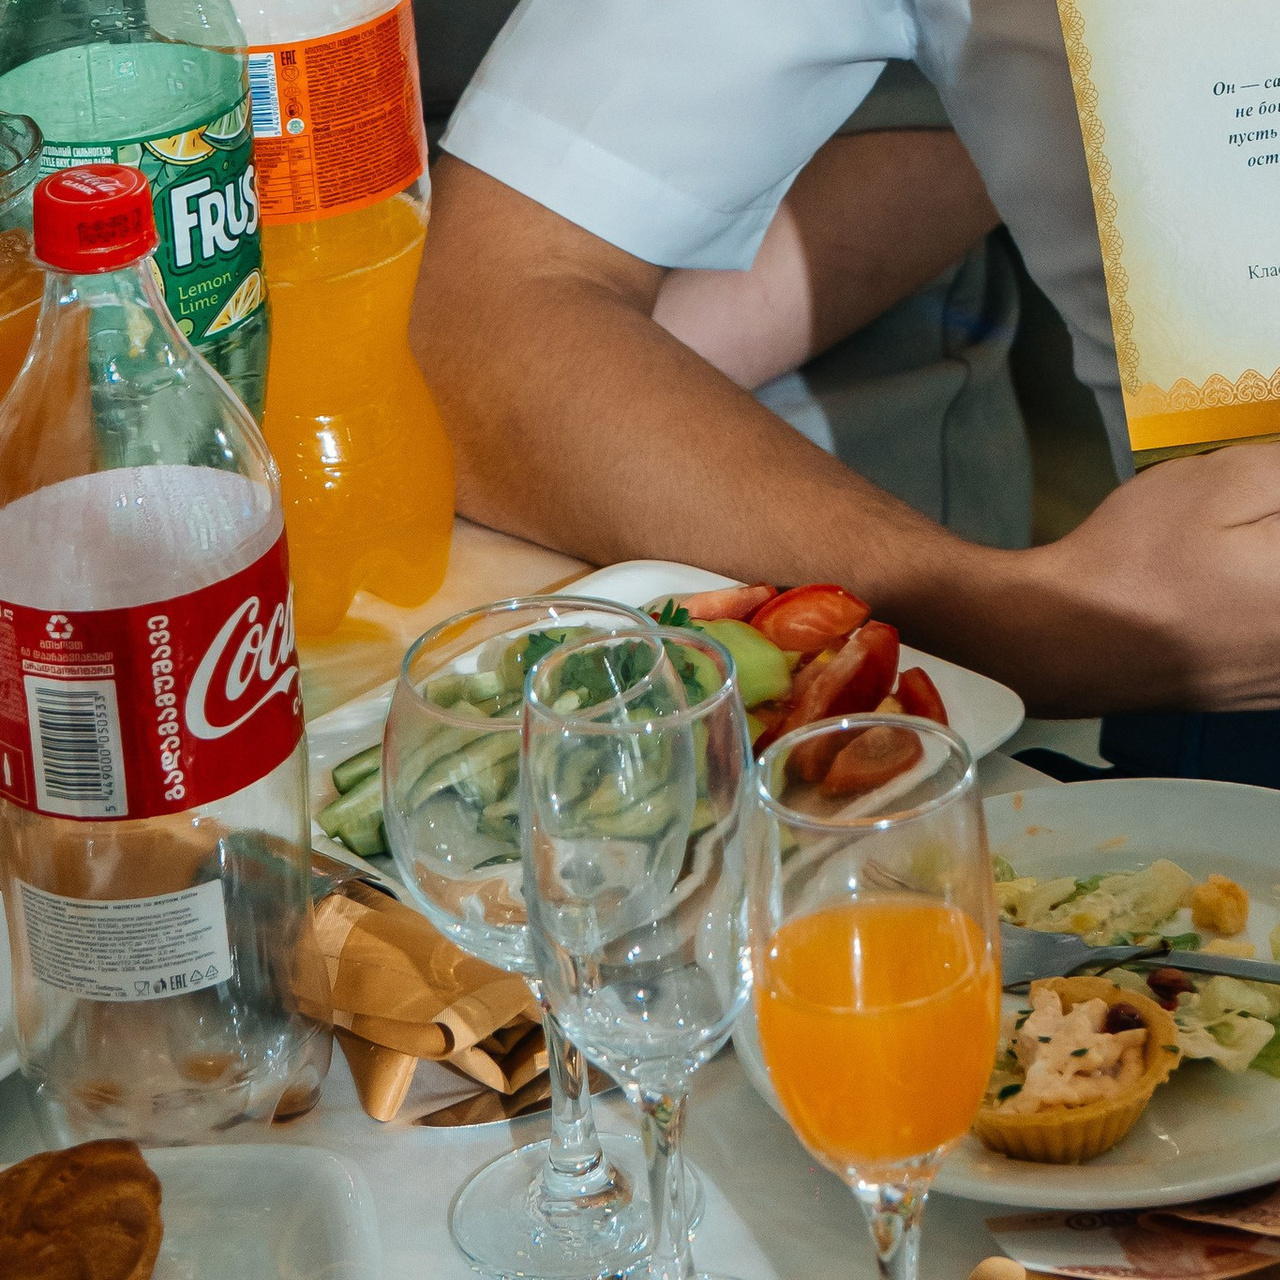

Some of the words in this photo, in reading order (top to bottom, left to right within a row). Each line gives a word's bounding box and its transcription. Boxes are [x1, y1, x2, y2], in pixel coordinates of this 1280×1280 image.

[1213, 81, 1236, 96] Он
[1235, 105, 1254, 119] не
[1228, 127, 1278, 148] пусть
[178, 271, 232, 300] Lemon
[179, 292, 219, 315] Lime
[95, 695, 110, 743] 050533
[100, 749, 114, 796] 449000
[105, 805, 117, 813] 5
[170, 972, 189, 991] EAC
